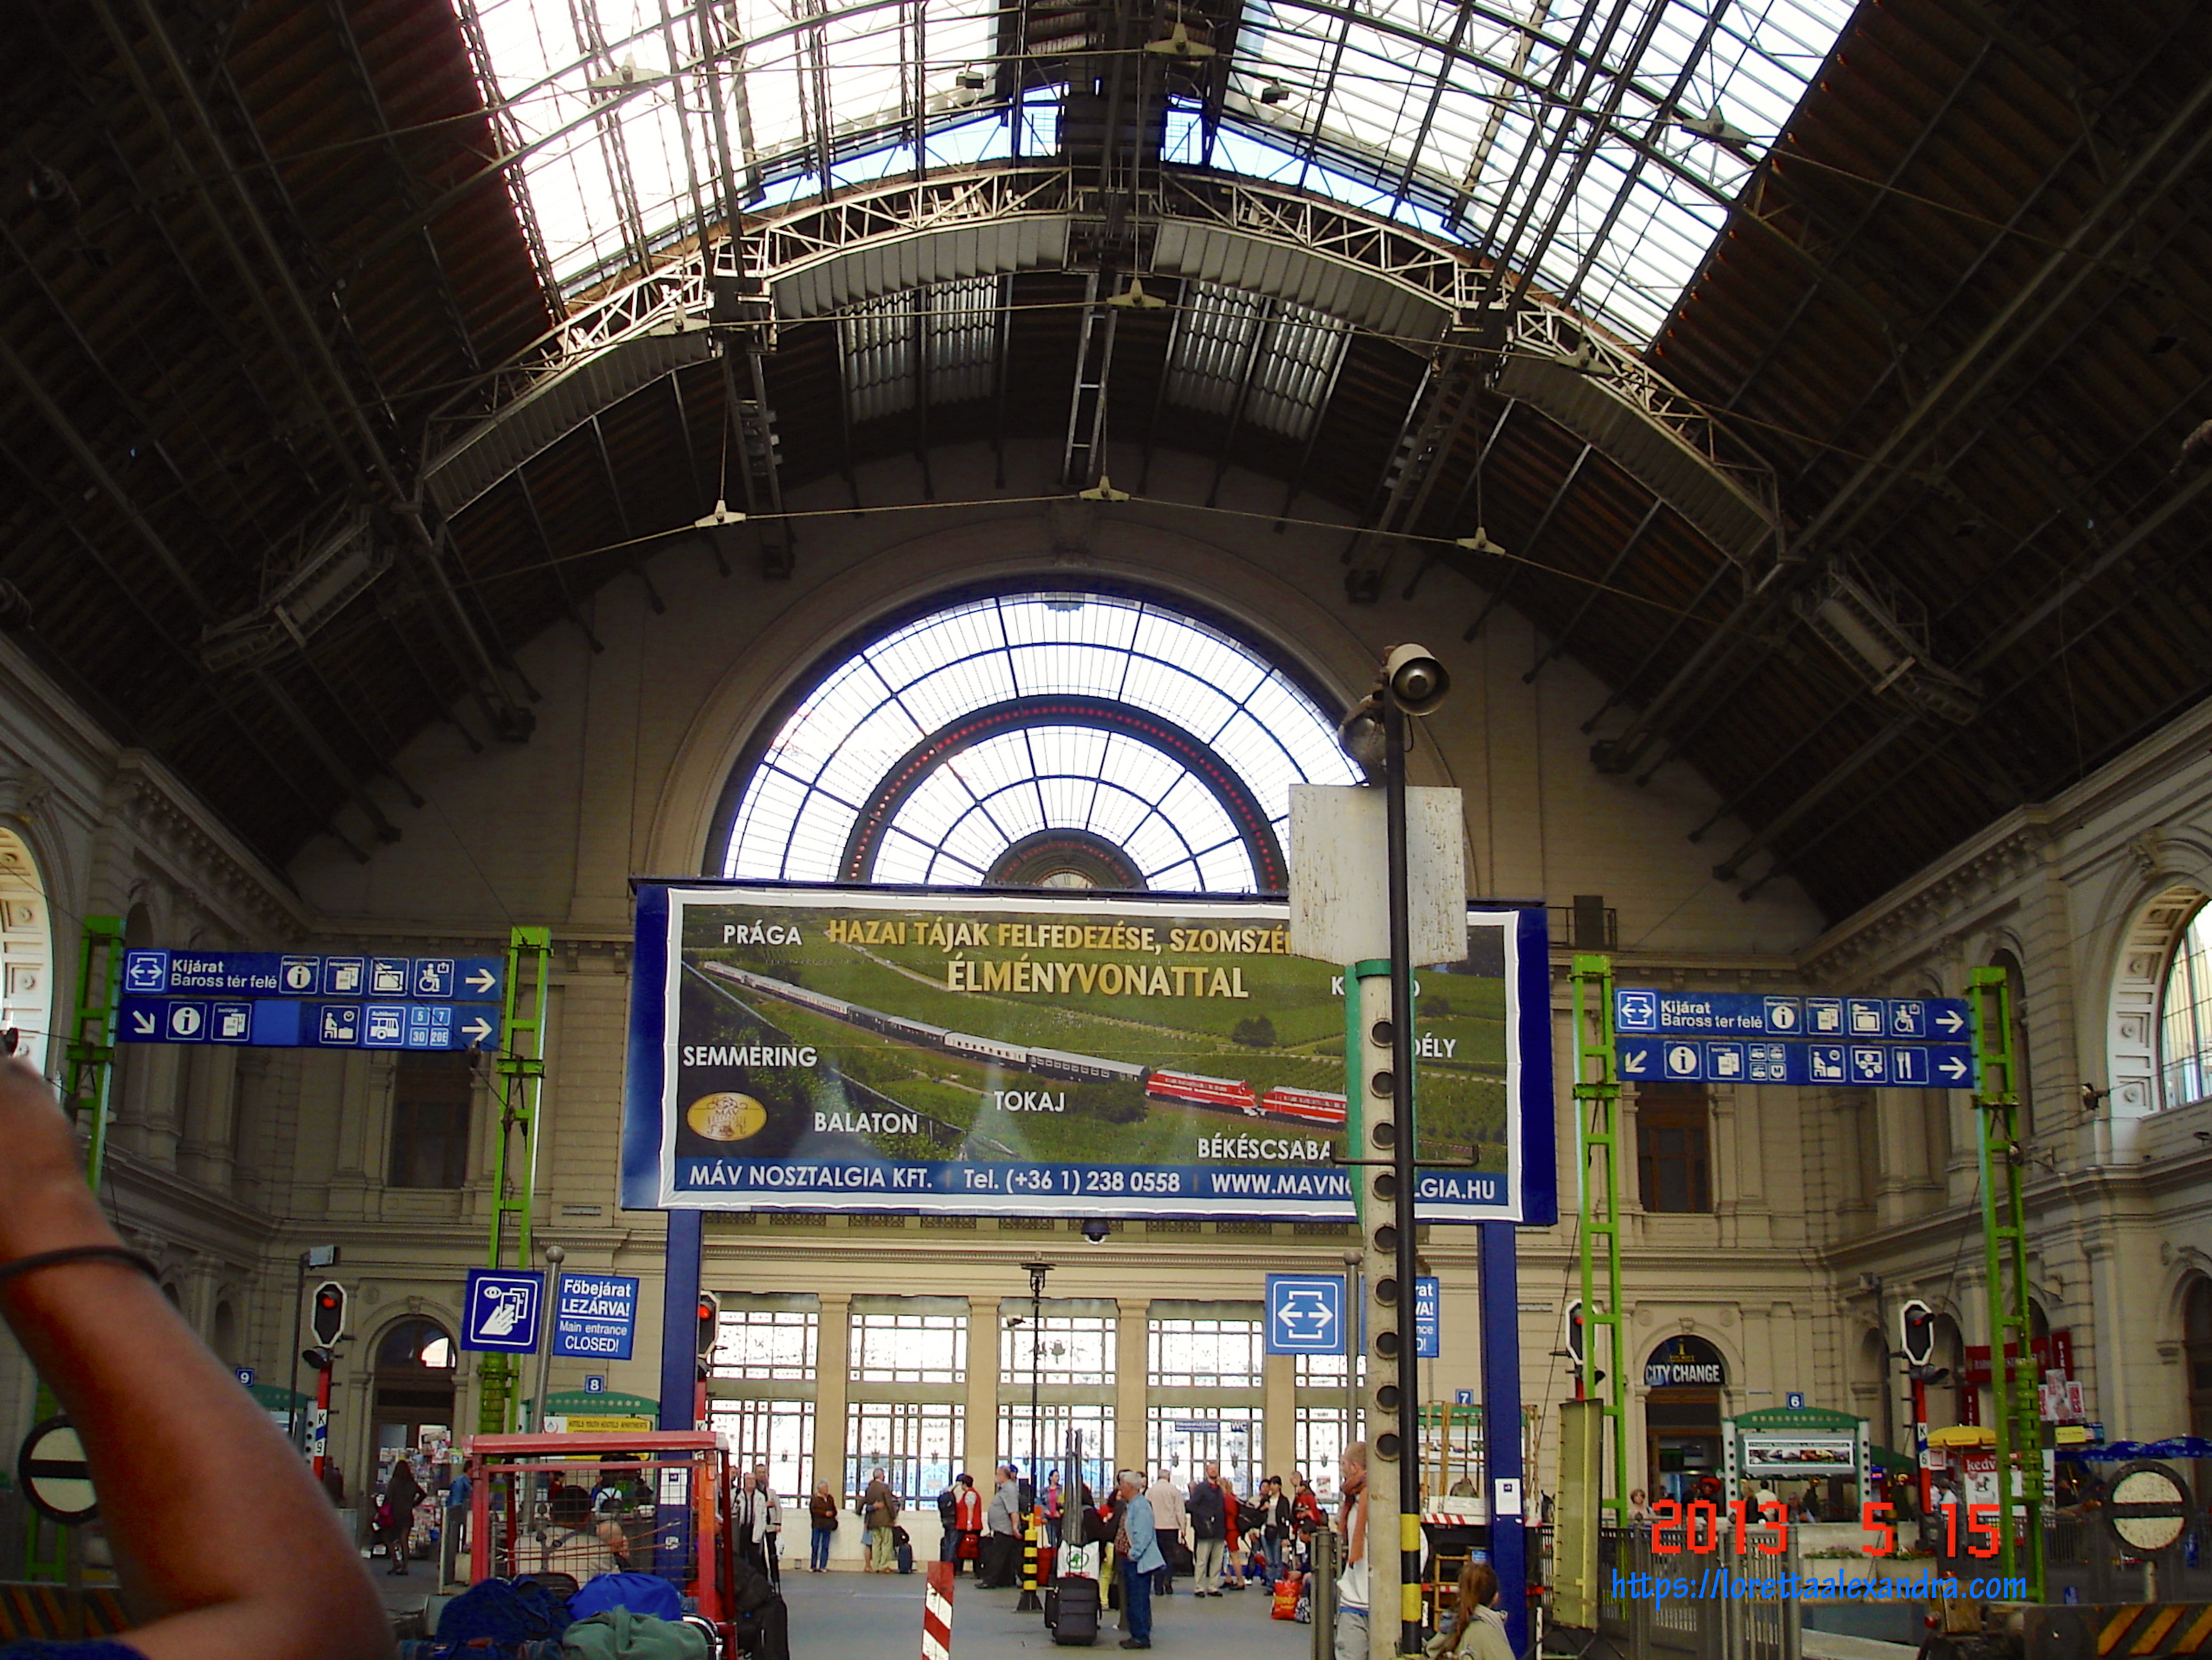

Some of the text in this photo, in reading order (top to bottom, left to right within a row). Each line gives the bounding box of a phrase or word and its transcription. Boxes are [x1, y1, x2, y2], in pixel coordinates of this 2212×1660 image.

[723, 920, 803, 945] PRÁGA
[830, 916, 1290, 955] HAZAI TÁJAK FELFEDEZÉSE, SZOMSZÉ
[172, 959, 223, 974] Kijárat
[171, 973, 277, 989] Baross tér felé
[947, 952, 1249, 998] ÉLMÉNYVONATTAL
[1660, 1000, 1711, 1015] Kijárat
[417, 1011, 444, 1022] 5 7
[1661, 1013, 1712, 1028] Baross
[1737, 1014, 1763, 1028] felé
[413, 1032, 447, 1042] 30 20E
[683, 1046, 818, 1067] SEMMERING
[994, 1091, 1065, 1112] TOKAJ
[814, 1112, 918, 1133] BALATON
[689, 1160, 932, 1187] MÁV NOSZTALGIA KFT.
[964, 1169, 1180, 1195] Tel. (+36 1) 238 0558
[564, 1279, 631, 1298] Főbejárat
[561, 1297, 630, 1317] LEZÁRVA!
[560, 1321, 627, 1336] Main entrance
[565, 1336, 619, 1352] CLOSED!
[240, 1372, 249, 1383] 9
[1646, 1365, 1720, 1383] CITY CHANGE
[590, 1379, 599, 1390] 8
[1460, 1393, 1469, 1404] 7
[1791, 1396, 1799, 1407] 6
[319, 1413, 325, 1425] K
[1920, 1426, 1926, 1435] K
[317, 1442, 322, 1452] 9
[1921, 1454, 1927, 1465] 6
